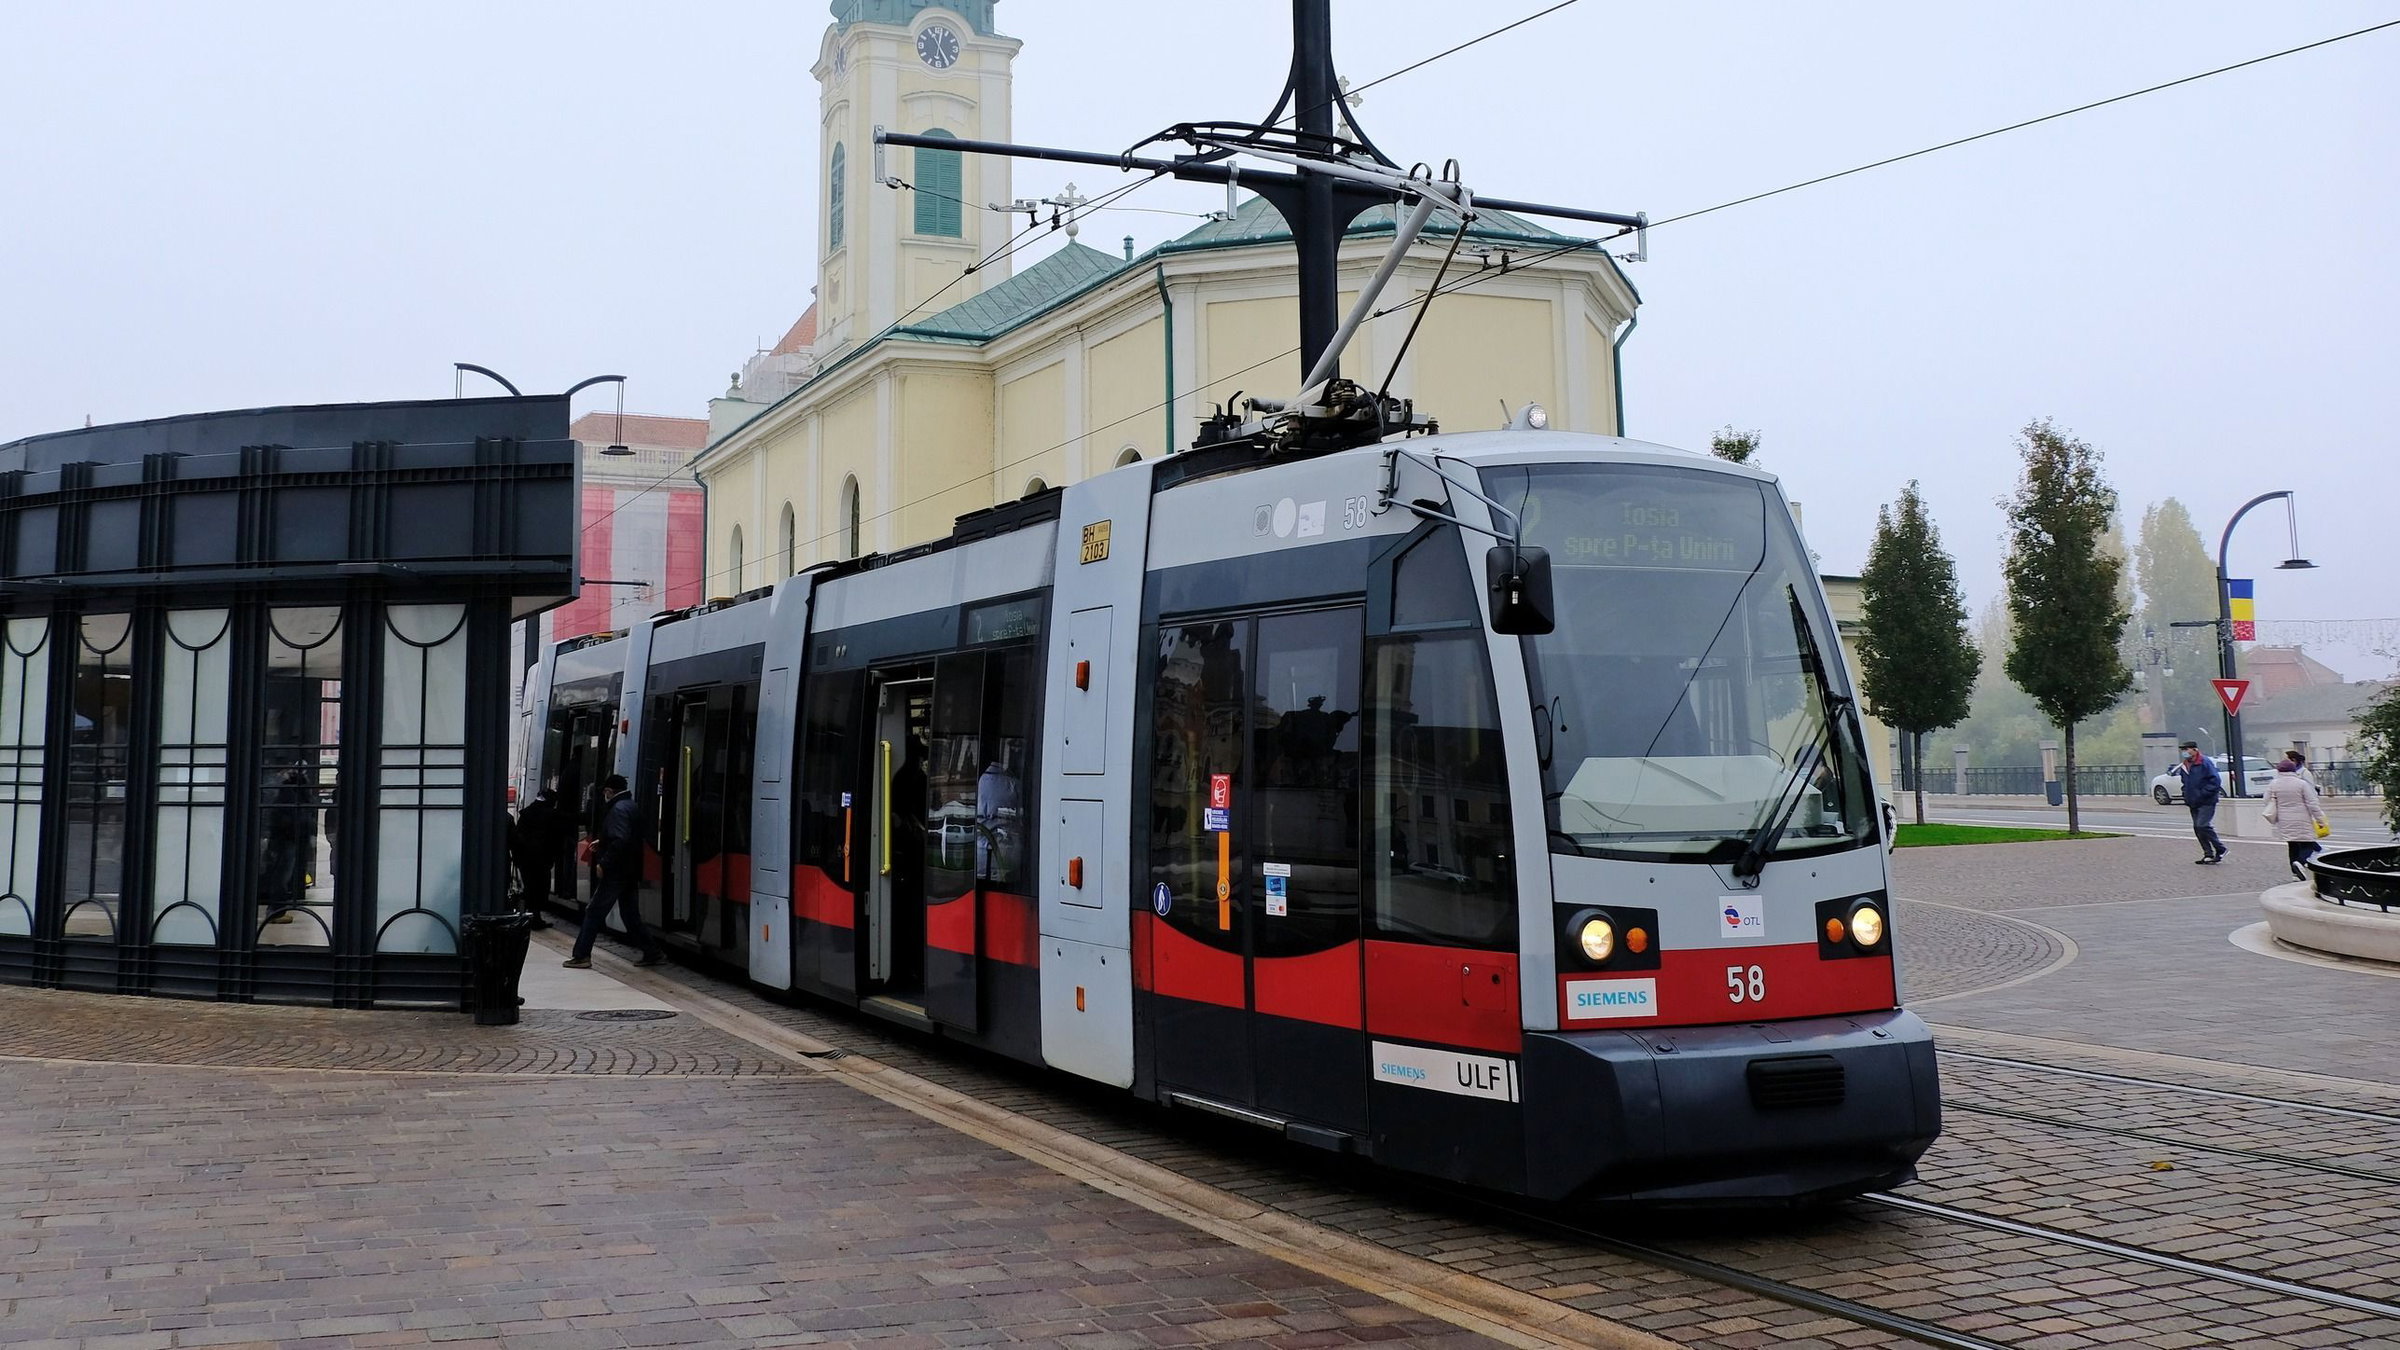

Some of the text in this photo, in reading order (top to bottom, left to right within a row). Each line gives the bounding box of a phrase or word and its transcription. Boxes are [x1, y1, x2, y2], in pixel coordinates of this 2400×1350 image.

[1343, 495, 1368, 531] 58
[1083, 526, 1095, 543] BH
[1084, 542, 1104, 561] 2103
[1564, 536, 1617, 559] spre
[1680, 536, 1735, 561] Unirii
[1743, 916, 1761, 926] OTL
[1726, 964, 1766, 1003] 58
[1577, 990, 1648, 1007] SIEMENS
[1381, 1061, 1501, 1091] SIEMENS ULF
